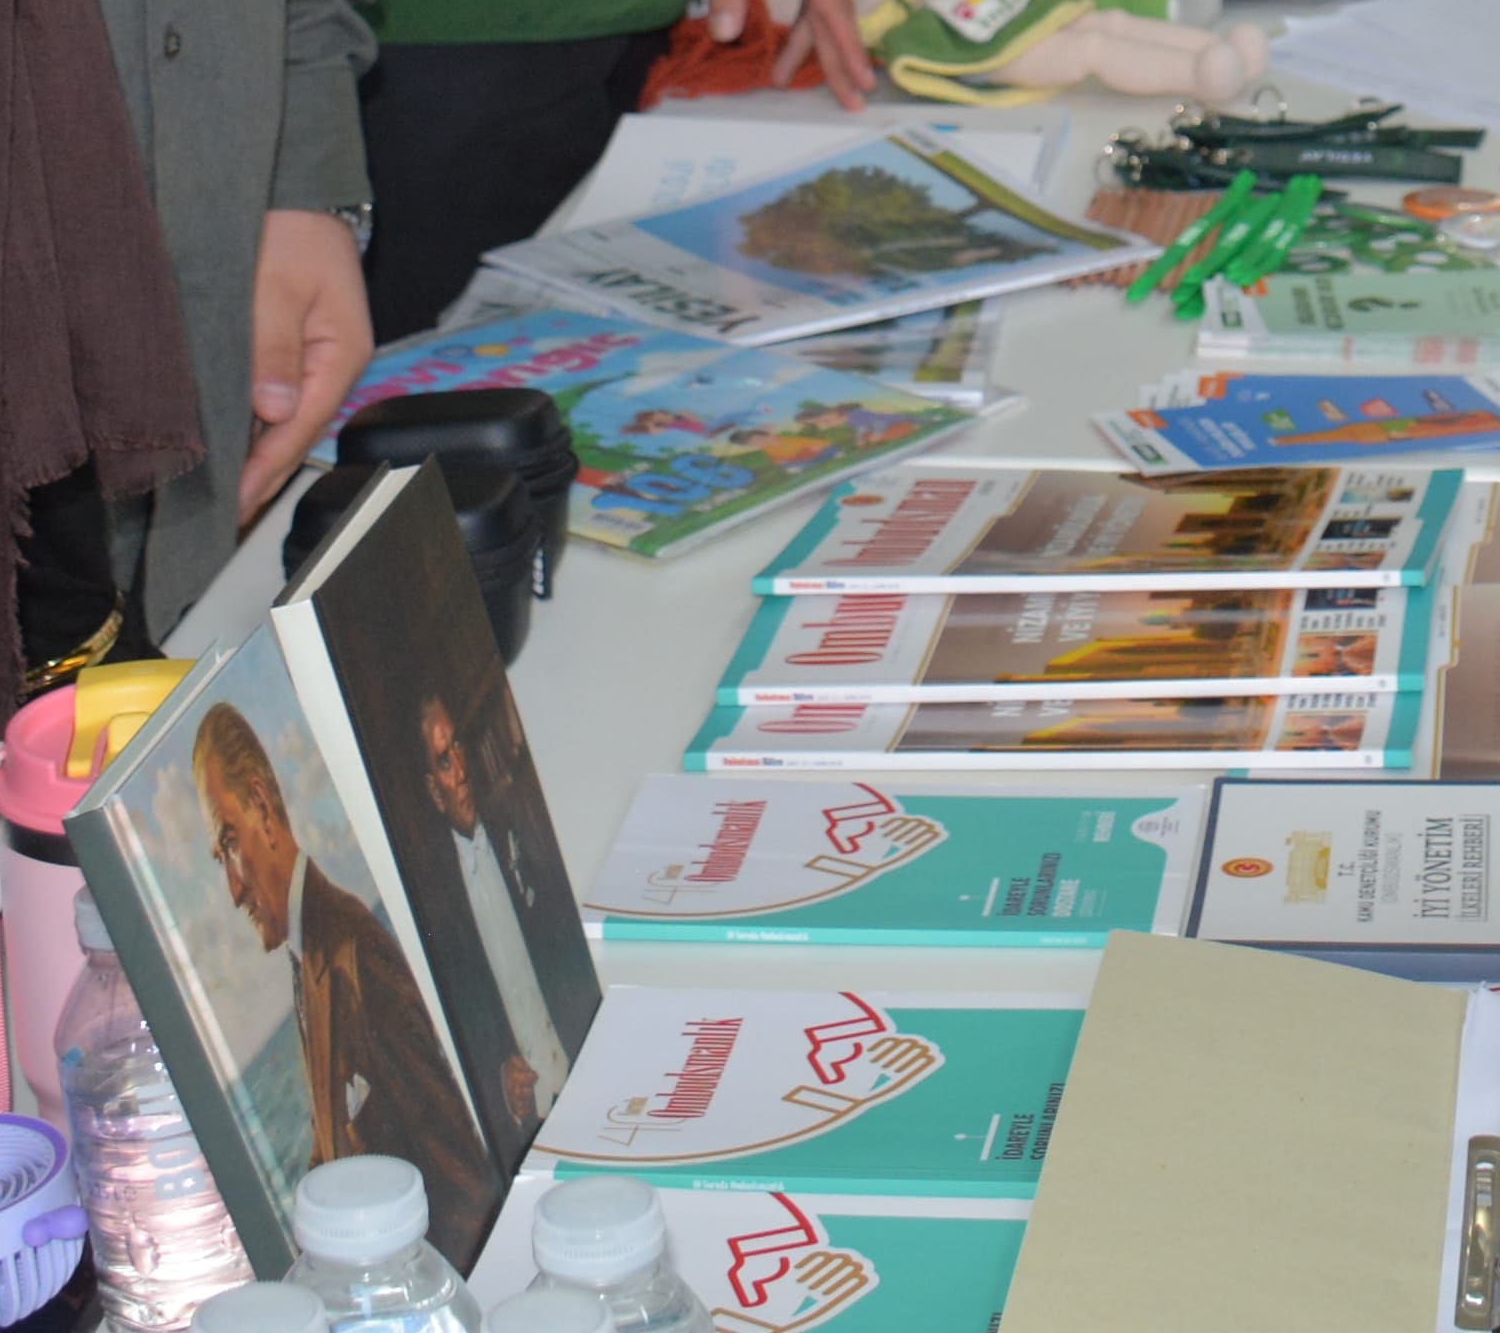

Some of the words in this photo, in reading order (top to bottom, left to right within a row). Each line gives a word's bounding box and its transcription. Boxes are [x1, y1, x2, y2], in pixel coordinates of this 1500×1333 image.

[683, 800, 768, 883] Ombudsmanlık
[1363, 809, 1382, 848] KURUMU
[1458, 818, 1484, 869] REHBERİ
[1414, 817, 1454, 893] YÖNETİM
[1357, 896, 1375, 923] KAMU
[1412, 898, 1451, 919] İYİ
[1454, 871, 1483, 919] İLKELERİ
[646, 1016, 744, 1119] Ombudsmanlık
[995, 1112, 1036, 1162] İDAREYLE
